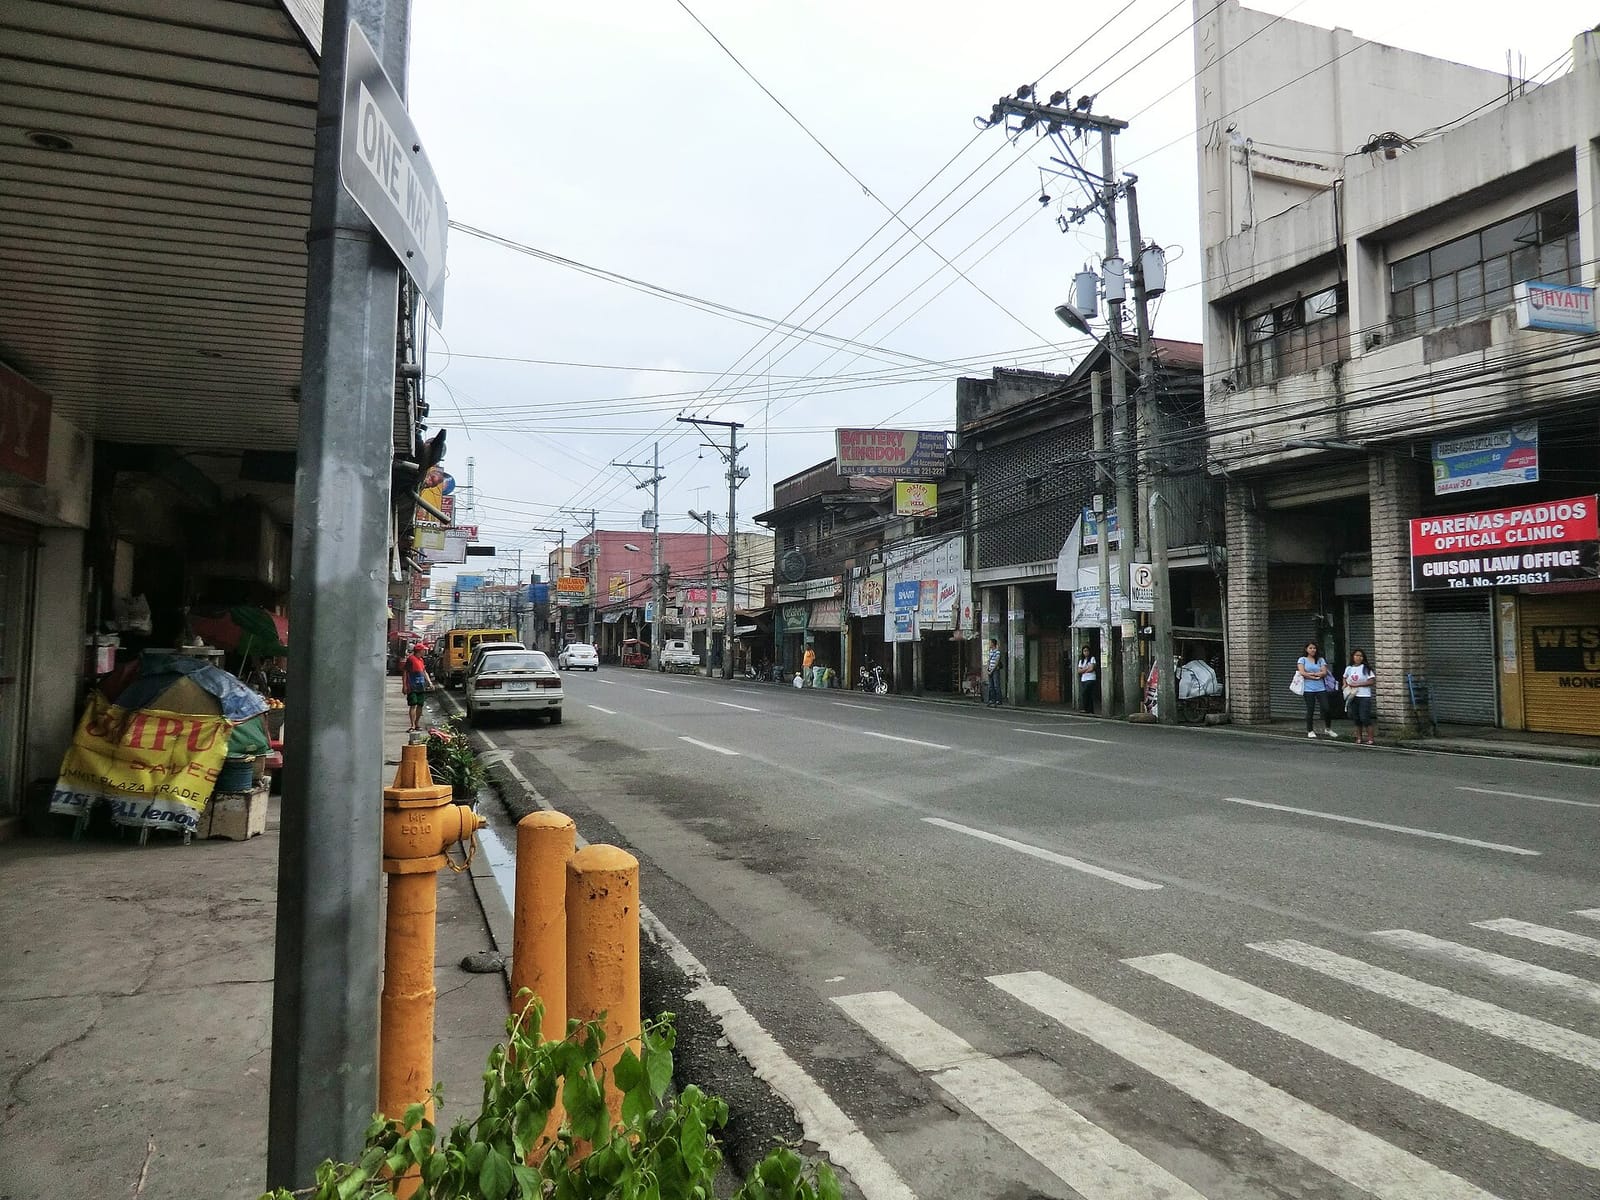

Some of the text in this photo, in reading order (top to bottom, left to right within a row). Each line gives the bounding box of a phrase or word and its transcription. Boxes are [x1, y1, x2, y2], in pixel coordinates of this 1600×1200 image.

[363, 102, 431, 252] ONE WAY
[1544, 289, 1590, 310] HYATT
[841, 430, 904, 447] BATTERY
[841, 446, 906, 461] KINGDOM
[842, 466, 867, 474] SALES
[1420, 503, 1586, 536] PAREÑAS-PADIOS
[1434, 525, 1565, 550] OPTICAL CLINIC
[1422, 550, 1581, 577] CUISON LAW OFFICE
[1448, 572, 1550, 588] Tel. No. 2258631
[100, 776, 145, 792] PLAZA
